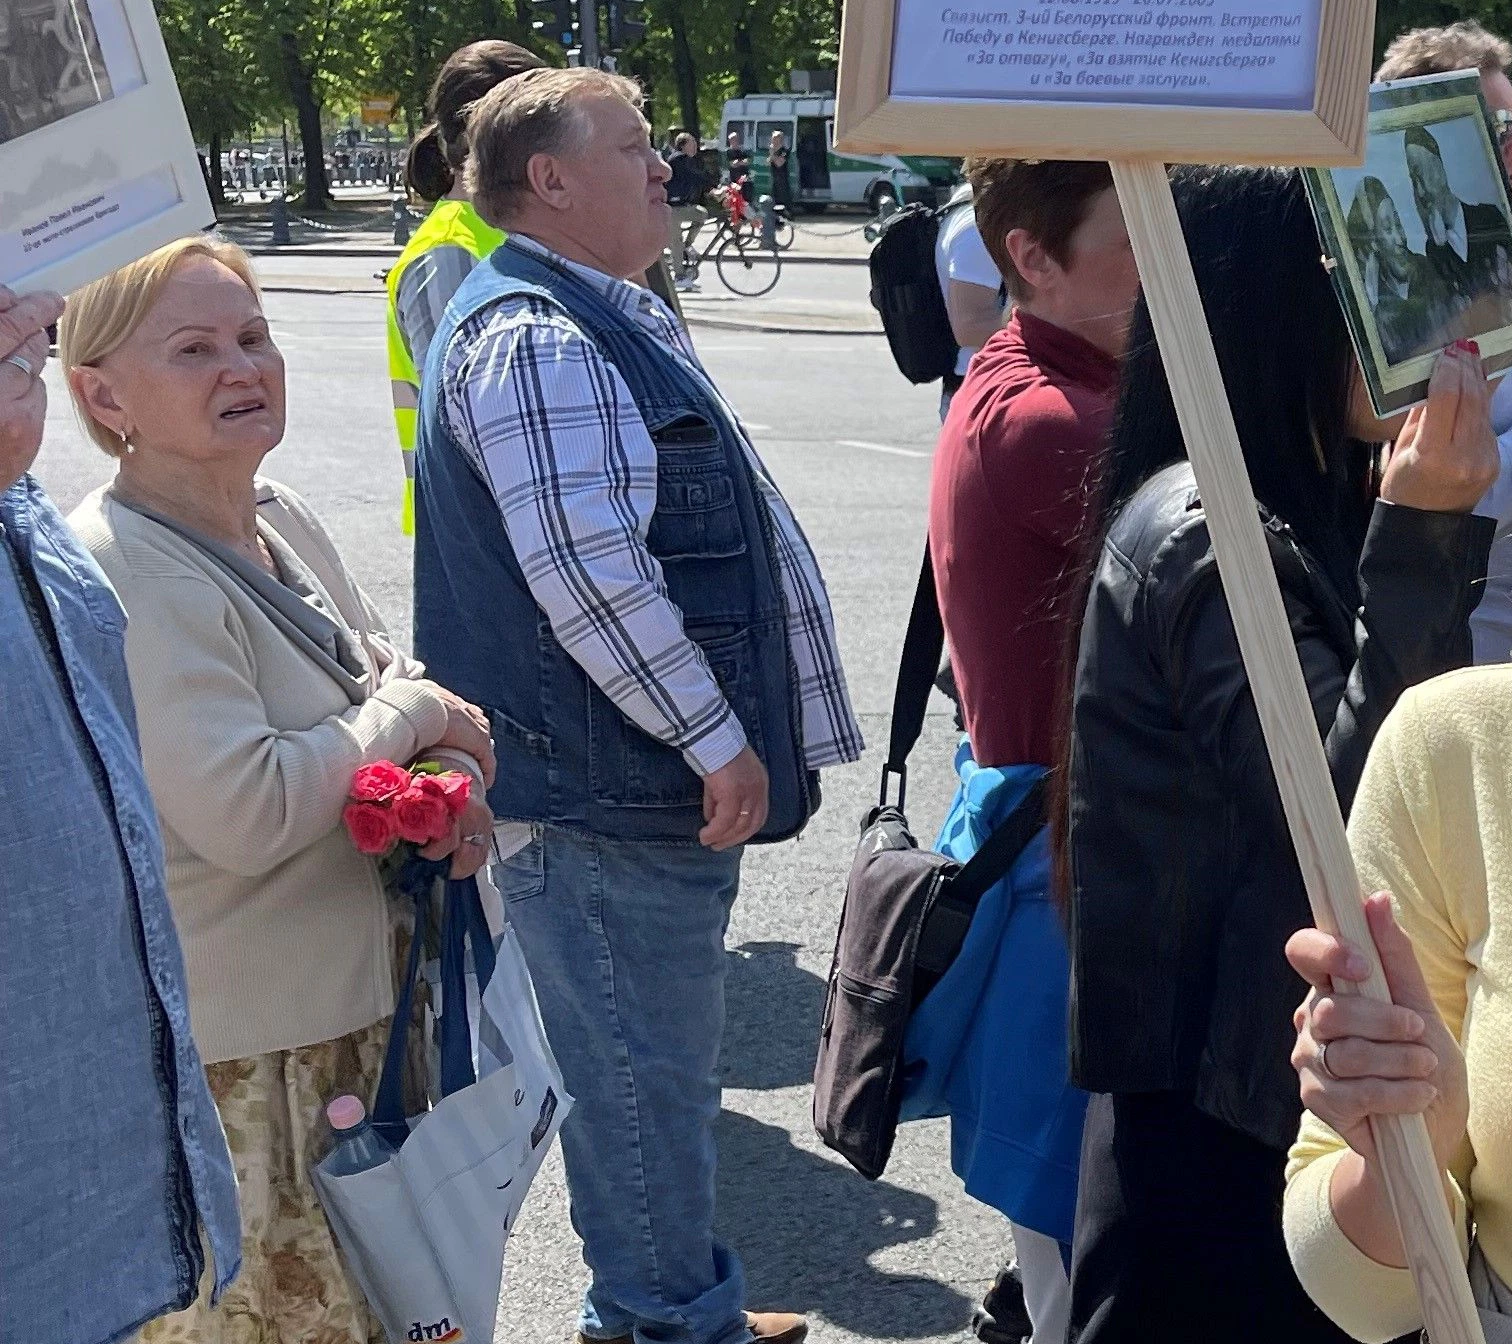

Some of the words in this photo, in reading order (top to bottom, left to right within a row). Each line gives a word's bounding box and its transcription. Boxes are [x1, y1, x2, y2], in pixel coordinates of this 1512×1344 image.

[1016, 9, 1050, 25] 3-ий
[1054, 10, 1153, 28] Белорусский
[1156, 11, 1215, 28] фронт.
[1220, 13, 1302, 29] Встретил
[943, 28, 1000, 47] Победу
[1004, 33, 1014, 44] в
[1018, 30, 1119, 47] Кенигсберге.
[1125, 31, 1215, 48] Награжден
[1221, 33, 1301, 47] медалями
[1108, 55, 1167, 66] взятие
[1030, 73, 1040, 85] и
[1076, 71, 1135, 86] боевые
[408, 1317, 450, 1342] dm
